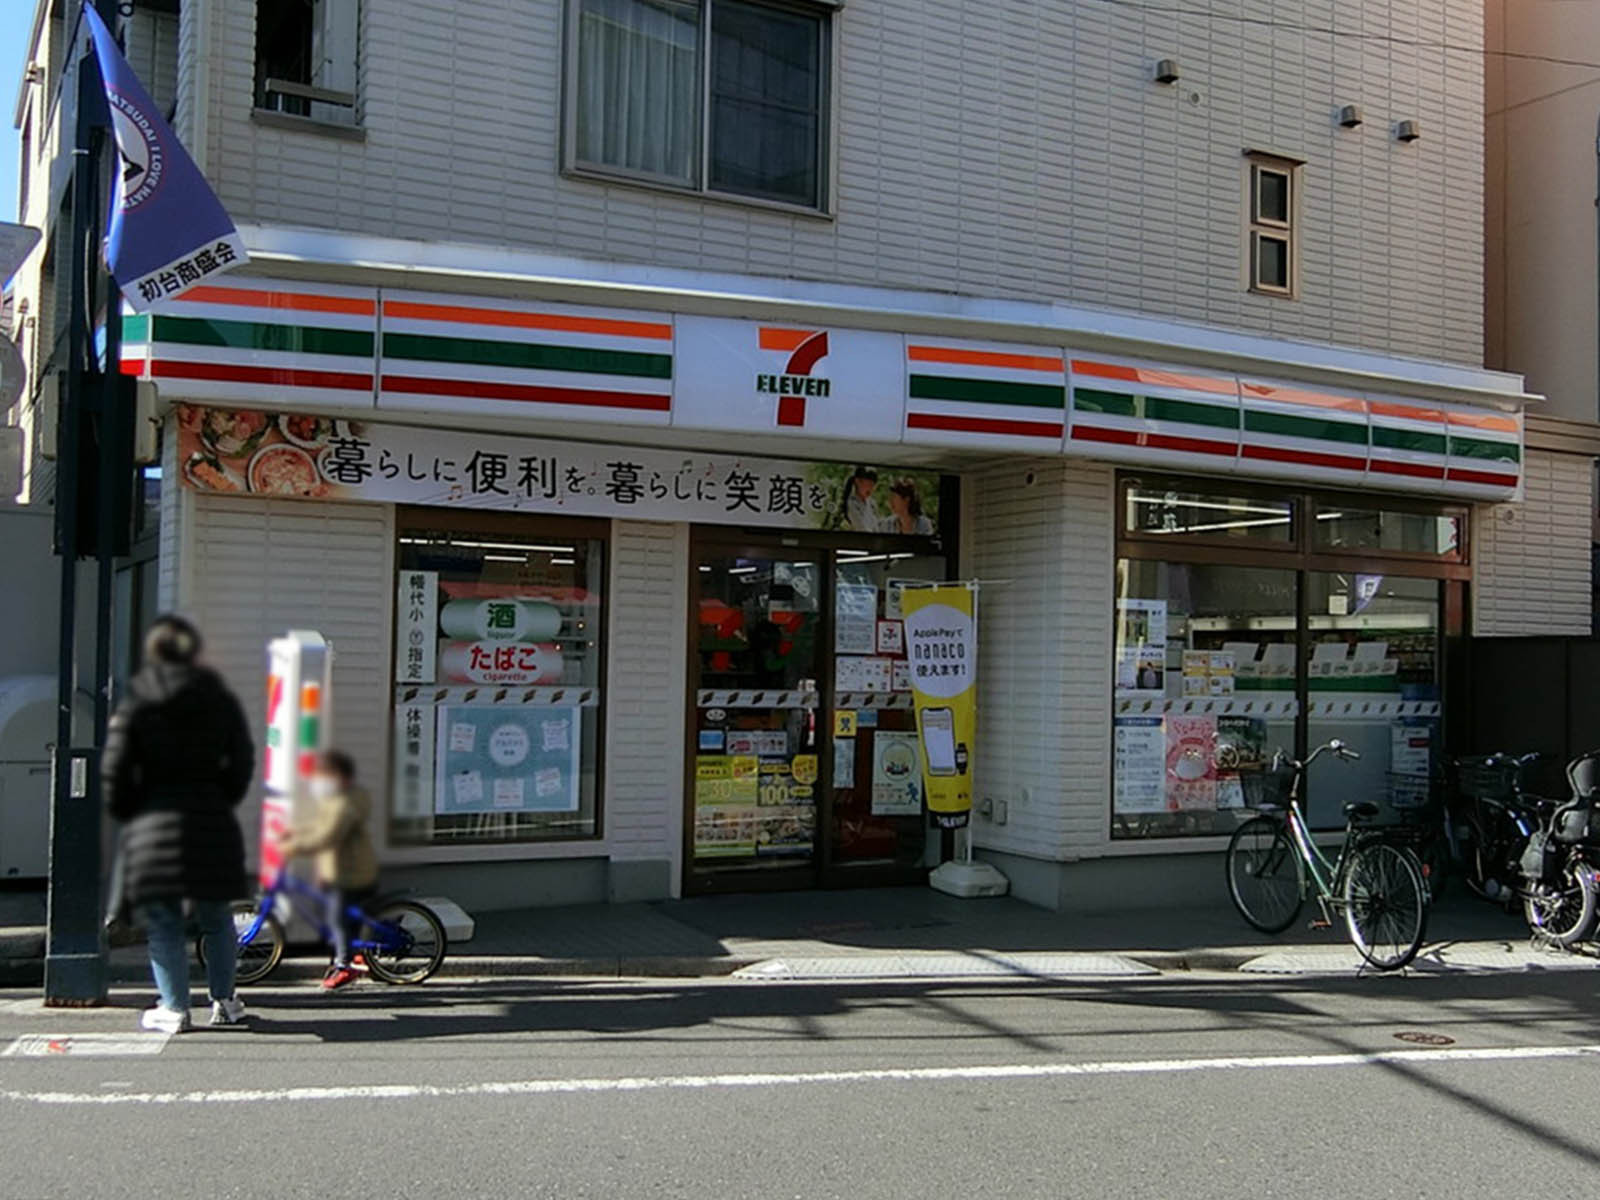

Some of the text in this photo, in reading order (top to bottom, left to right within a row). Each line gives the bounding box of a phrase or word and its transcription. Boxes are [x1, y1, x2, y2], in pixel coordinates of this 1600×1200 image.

[145, 155, 162, 186] LOVE
[138, 241, 238, 303] 初台商盛会
[758, 327, 828, 427] 7
[487, 603, 517, 628] 酒
[470, 645, 537, 671] たばこ
[914, 642, 966, 659] nanaco
